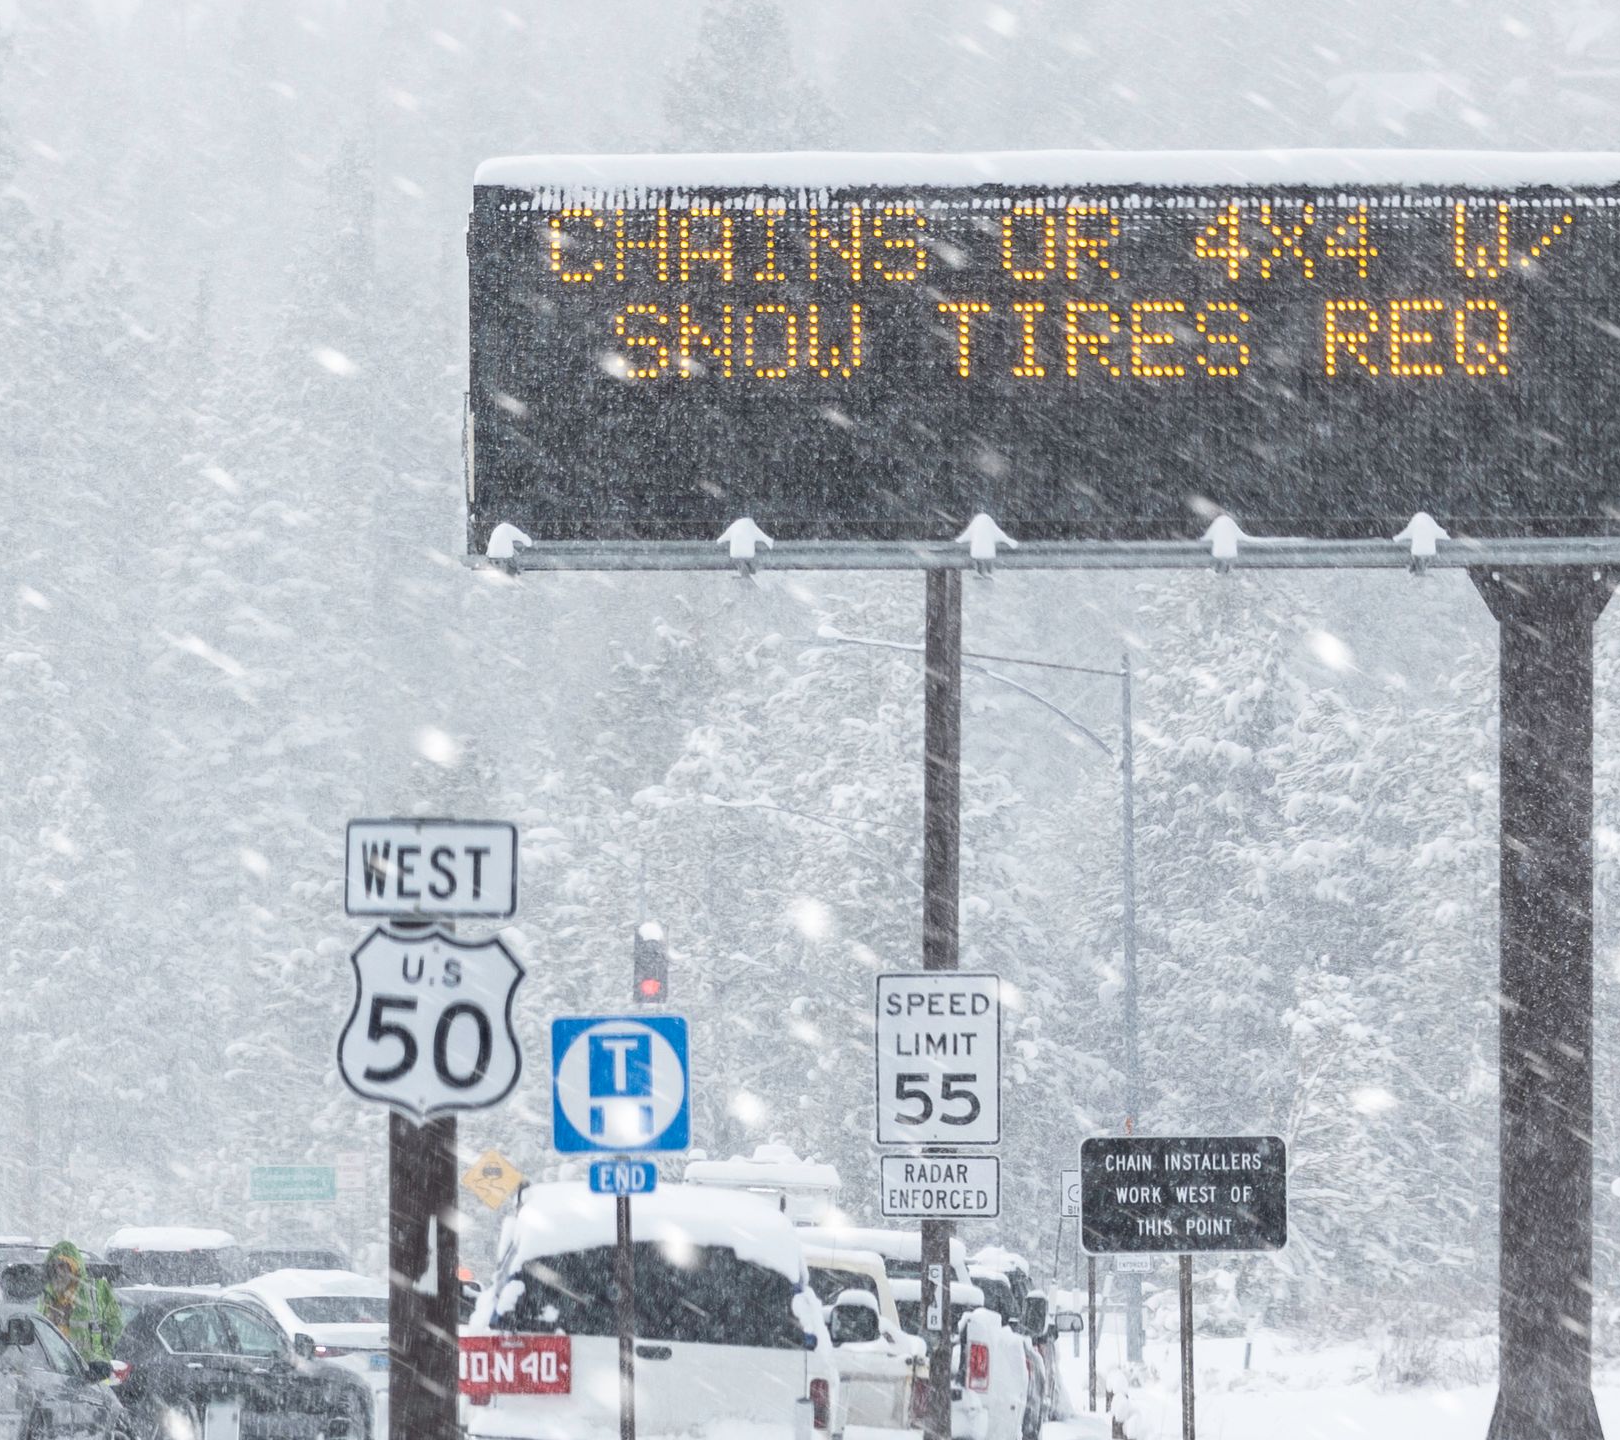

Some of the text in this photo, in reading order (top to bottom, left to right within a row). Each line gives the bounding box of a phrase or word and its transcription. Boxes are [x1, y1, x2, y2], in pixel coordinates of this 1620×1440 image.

[549, 207, 928, 282] CHAINS
[1001, 206, 1122, 281] OR
[1194, 203, 1380, 281] 4X4
[613, 299, 1509, 378] SNOW TIRES REQ
[362, 839, 491, 901] WEST
[886, 992, 991, 1017] SPEED
[363, 993, 493, 1089] 50
[896, 1032, 978, 1057] LIMIT
[894, 1072, 982, 1126] 55
[904, 1163, 969, 1184] RADAR
[1104, 1152, 1263, 1172] CHAIN INSTALLERS
[599, 1164, 646, 1192] END
[888, 1188, 989, 1210] ENFORCED
[1115, 1185, 1253, 1204] WORK WEST OF
[1136, 1218, 1233, 1236] THIS POINT
